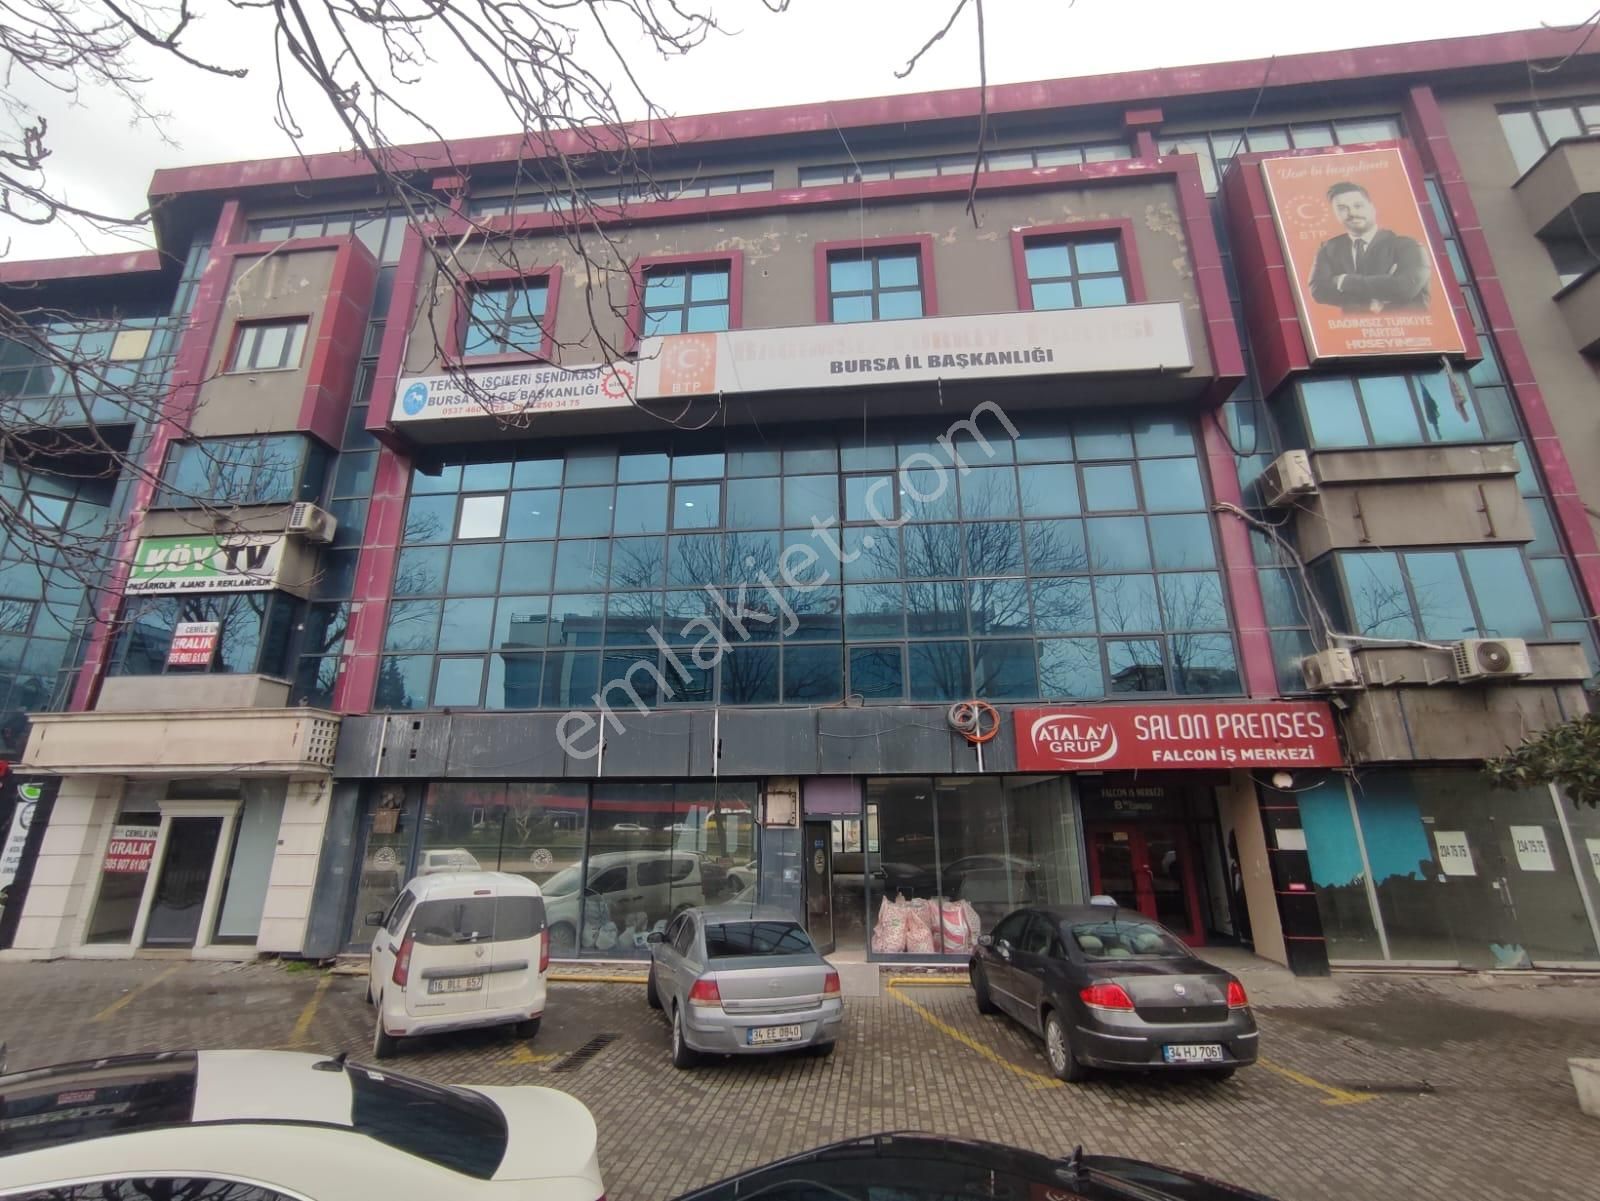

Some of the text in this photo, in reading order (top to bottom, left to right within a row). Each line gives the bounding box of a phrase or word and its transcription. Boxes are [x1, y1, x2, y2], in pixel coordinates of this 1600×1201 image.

[830, 347, 1054, 374] BURSA İL BAŞKANLIĞI
[428, 395, 469, 406] BURSA
[520, 383, 599, 400] BAŞKANLIĞI
[672, 382, 701, 393] BTP
[144, 544, 272, 573] KÖY TV
[180, 580, 205, 588] AJANS
[1134, 712, 1325, 741] SALON PRENSES
[1038, 721, 1110, 753] ATALAY GRUP
[1152, 744, 1315, 762] FALCON İŞ MERKEZİ
[109, 841, 153, 855] KİRALIK
[753, 1025, 799, 1040] 34 EE 0840
[1169, 1046, 1221, 1057] 34 HJ 7061
